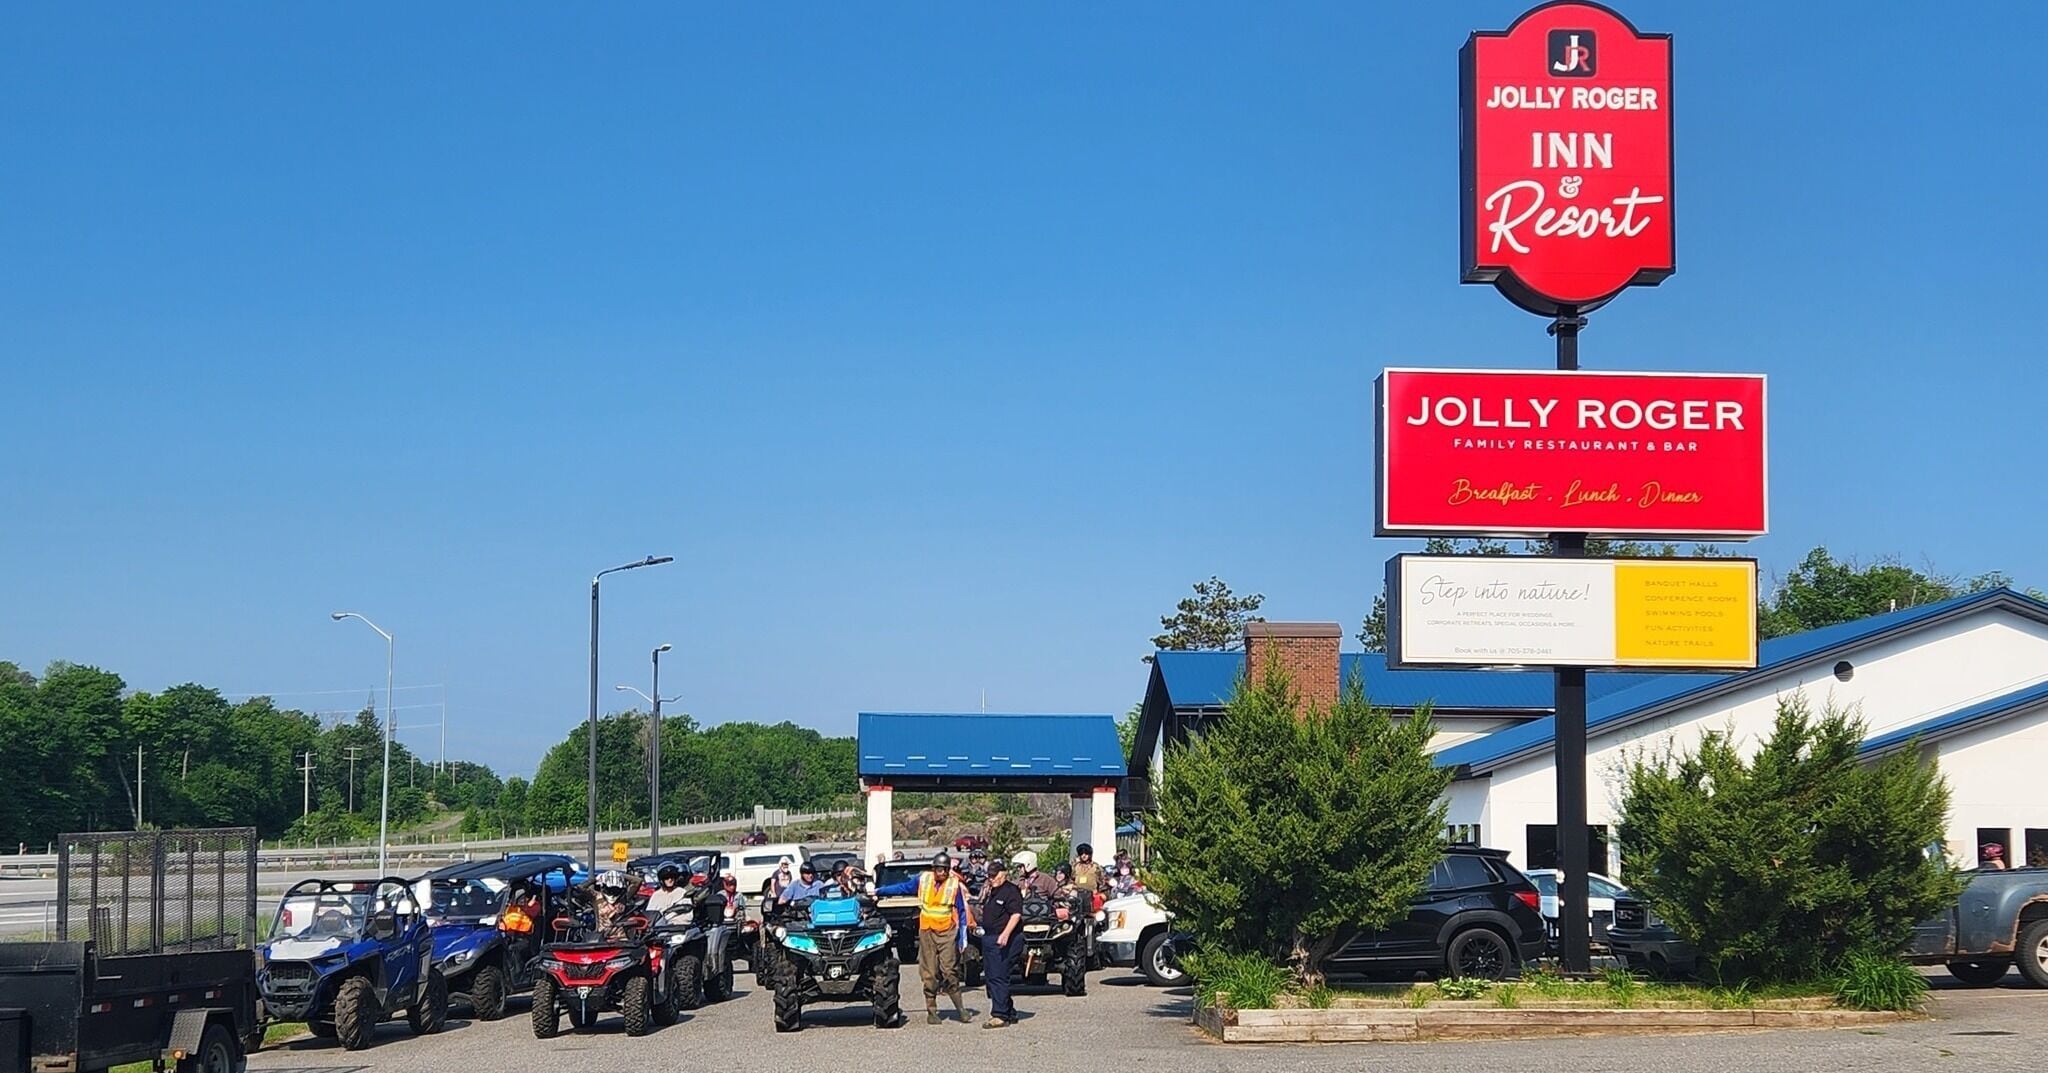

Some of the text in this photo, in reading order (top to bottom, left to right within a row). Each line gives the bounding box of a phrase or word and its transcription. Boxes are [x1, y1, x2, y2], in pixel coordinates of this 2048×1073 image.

[1487, 86, 1658, 110] JOLLY ROGER
[1532, 132, 1613, 168] INN
[1558, 176, 1583, 198] &
[1485, 180, 1664, 253] Resort
[1407, 396, 1745, 430] JOLLY ROGER
[1453, 438, 1697, 451] FAMILY RESTAURANT & BAR
[1448, 478, 1703, 508] Breakfast Lunch Dinner
[1420, 575, 1590, 607] Step into nature!
[1455, 647, 1471, 655] Book
[1473, 647, 1489, 655] with
